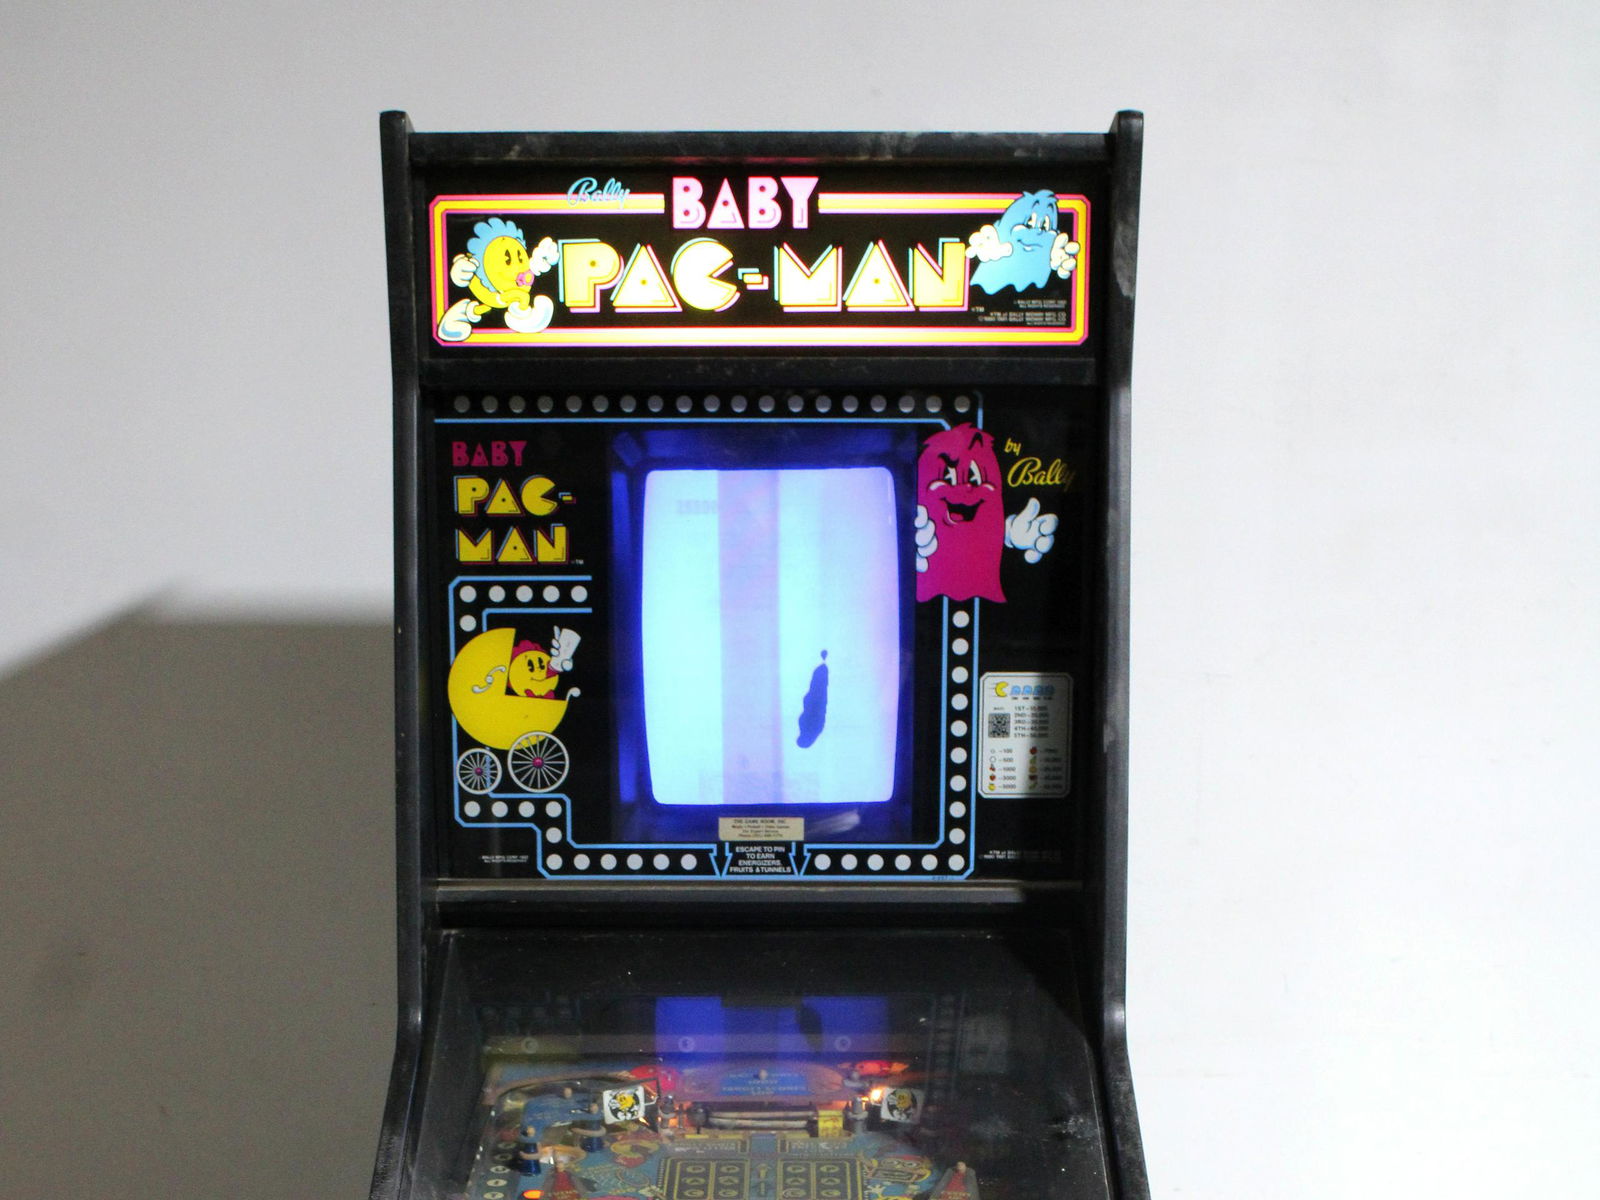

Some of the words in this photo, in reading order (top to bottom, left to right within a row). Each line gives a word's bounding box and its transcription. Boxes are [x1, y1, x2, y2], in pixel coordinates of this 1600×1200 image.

[567, 177, 630, 208] Bally
[672, 176, 819, 229] BABY
[558, 237, 970, 312] PAC-MAN
[452, 441, 528, 467] BABY
[1004, 437, 1021, 456] by
[453, 474, 577, 517] PAC-
[455, 523, 570, 565] MAN
